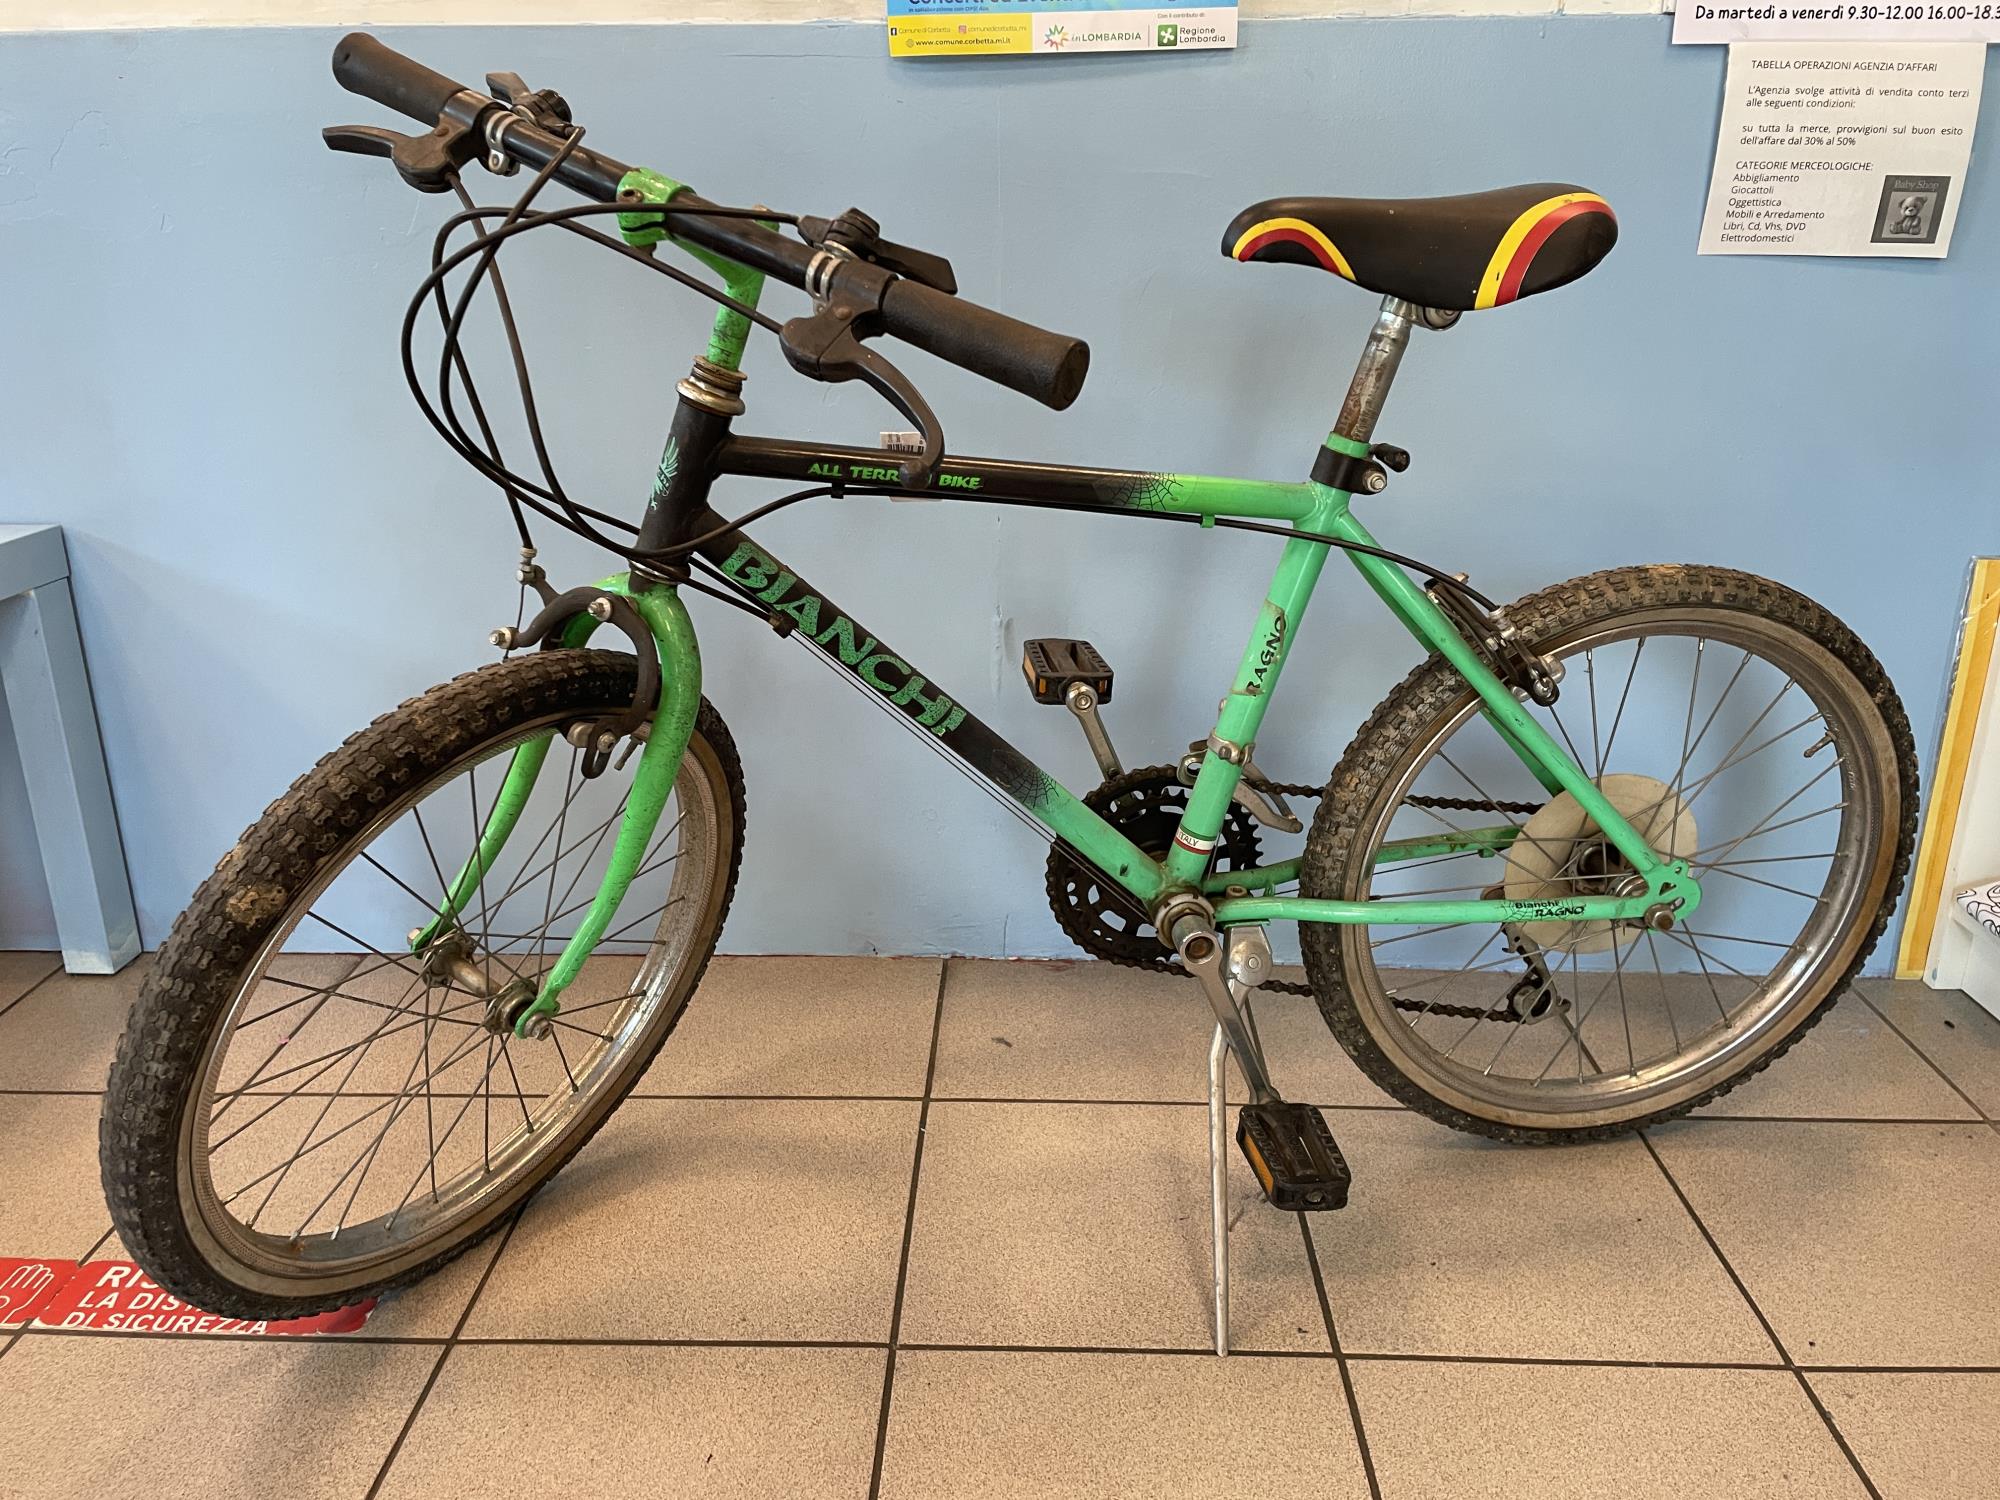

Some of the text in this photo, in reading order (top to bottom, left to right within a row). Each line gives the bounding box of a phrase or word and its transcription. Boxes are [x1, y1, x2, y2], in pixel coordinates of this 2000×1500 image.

[1695, 5, 1714, 19] Da
[1780, 9, 1787, 19] a
[1848, 5, 1924, 19] 9.30-12.00
[1180, 27, 1216, 35] Regione
[916, 38, 1011, 46] www.comune.corbetta.mi.it
[1180, 34, 1226, 43] Lombardia
[1751, 60, 1937, 72] TABELLA OPERAZIONI AGENZIA D'AFFARI
[1748, 86, 1969, 98] L'Agenzia svolge attività di vendita conto terzi
[1746, 99, 1856, 109] alle seguenti condizioni:
[1758, 124, 1780, 133] tutta
[1785, 124, 1794, 133] la
[1799, 125, 1831, 134] merce,
[1836, 124, 1887, 136] provvigioni
[1892, 125, 1906, 134] sul
[1911, 125, 1936, 135] buon
[1941, 126, 1963, 136] esito
[1740, 136, 1856, 146] dell'affare dal 30% al 50%
[1736, 161, 1873, 171] CATEGORIE MERCEOLOGICHE:
[1733, 174, 1800, 184] Abbigliamento
[1731, 186, 1774, 194] Giocattoli
[1894, 180, 1939, 191] Baby Shop
[1728, 198, 1782, 208] Oggettistica
[1726, 210, 1754, 219] Mobili
[1763, 210, 1825, 219] Arredamento
[1723, 222, 1806, 232] Libri, Cd, Vhs, DVD
[1721, 234, 1794, 243] Elettrodomestici
[808, 463, 842, 477] ALL
[939, 474, 983, 490] BIKE
[720, 542, 967, 736] BIANCHI
[1246, 616, 1287, 697] RAGNO
[1514, 901, 1560, 909] Bianchi
[1534, 906, 1586, 917] RAGNO
[77, 1291, 119, 1309] LA
[62, 1312, 95, 1328] DI
